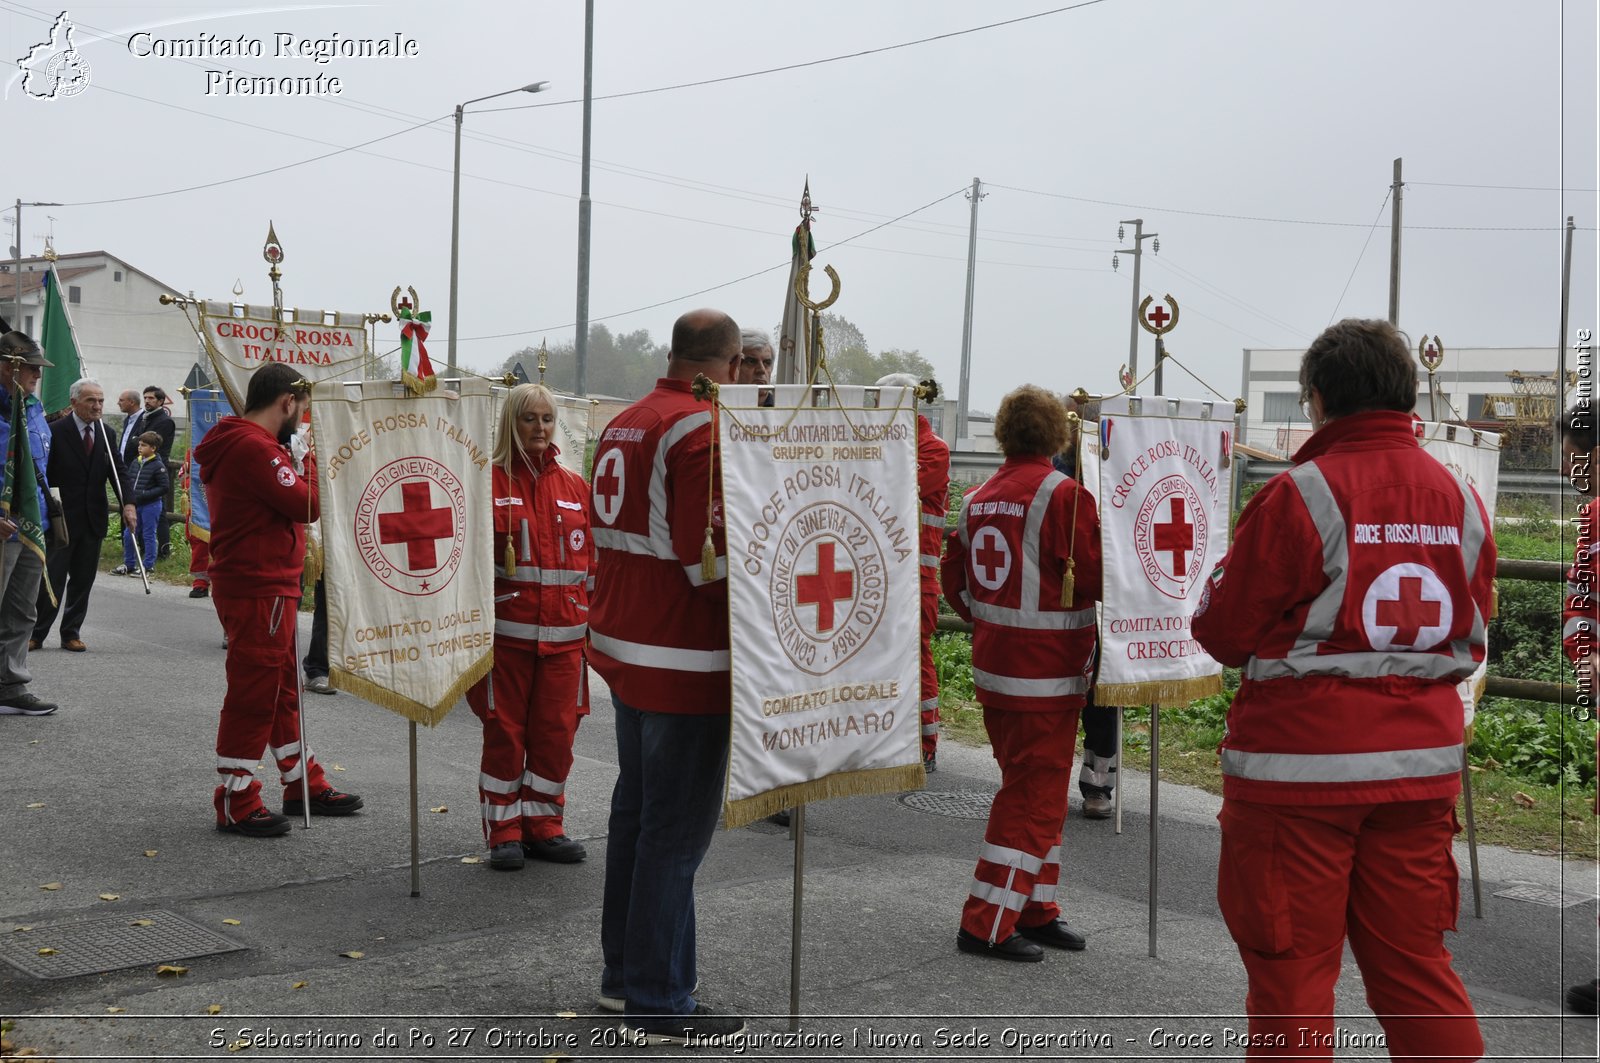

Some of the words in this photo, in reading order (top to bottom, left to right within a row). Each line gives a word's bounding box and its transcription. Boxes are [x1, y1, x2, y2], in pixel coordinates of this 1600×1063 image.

[216, 322, 285, 343] CROCE
[295, 329, 354, 347] ROSSA
[242, 344, 332, 365] ITALIANA
[326, 429, 372, 480] CROCE
[372, 413, 428, 435] ROSSA
[436, 416, 489, 472] ITALIANA
[729, 424, 770, 442] CORPO
[774, 424, 829, 442] VOLONTARI
[832, 425, 849, 442] DEL
[852, 424, 907, 441] SOCCORSO
[773, 446, 824, 459] GRUPPO
[832, 446, 882, 460] PIONIERI
[1111, 455, 1149, 509] CROCE
[1147, 440, 1181, 464] ROSSA
[358, 484, 392, 579] CONVENZIONE
[375, 473, 390, 489] DI
[388, 461, 439, 479] GINEVRA
[440, 472, 454, 489] 22
[451, 487, 465, 543] AGOSTO
[744, 490, 785, 576] CROCE
[784, 465, 841, 500] ROSSA
[848, 473, 912, 563] ITALIANA
[796, 508, 847, 539] GINEVRA
[1137, 497, 1161, 582] CONVENZIONE
[1153, 488, 1163, 501] DI
[1188, 493, 1196, 506] 22
[1194, 507, 1206, 557] AGOSTO
[1384, 523, 1420, 543] ROSSA
[784, 532, 800, 556] DI
[847, 526, 868, 551] 22
[859, 553, 882, 626] AGOSTO
[355, 620, 432, 643] COMITATO
[438, 609, 481, 631] LOCALE
[775, 555, 816, 666] CONVENZIONE
[1110, 616, 1183, 634] COMITATO
[345, 646, 420, 671] SETTIMO
[832, 625, 861, 660] 1864
[763, 690, 827, 716] COMITATO
[831, 682, 898, 703] LOCALE
[762, 710, 895, 752] MONTANARO
